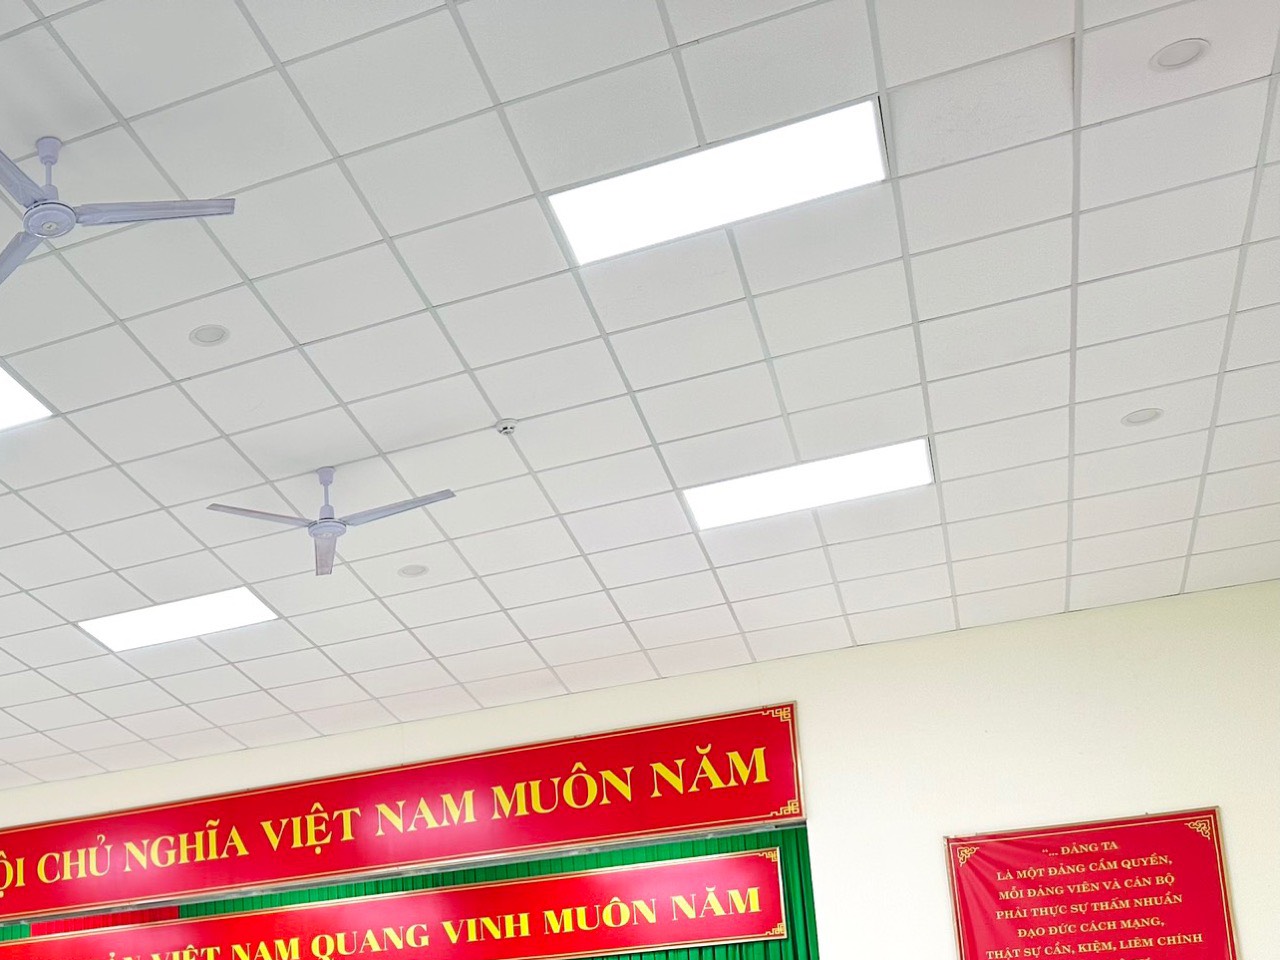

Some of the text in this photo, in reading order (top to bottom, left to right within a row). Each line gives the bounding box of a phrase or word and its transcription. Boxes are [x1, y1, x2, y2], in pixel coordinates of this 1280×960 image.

[37, 833, 113, 885] CHỦ
[124, 820, 248, 871] NGHĨA
[262, 803, 361, 856] VIỆT
[374, 789, 476, 837] NAM
[491, 762, 632, 818] MUÔN
[649, 743, 769, 798] NĂM
[441, 911, 531, 945] VINH
[543, 896, 657, 935] MUÔN
[671, 885, 762, 918] NĂM
